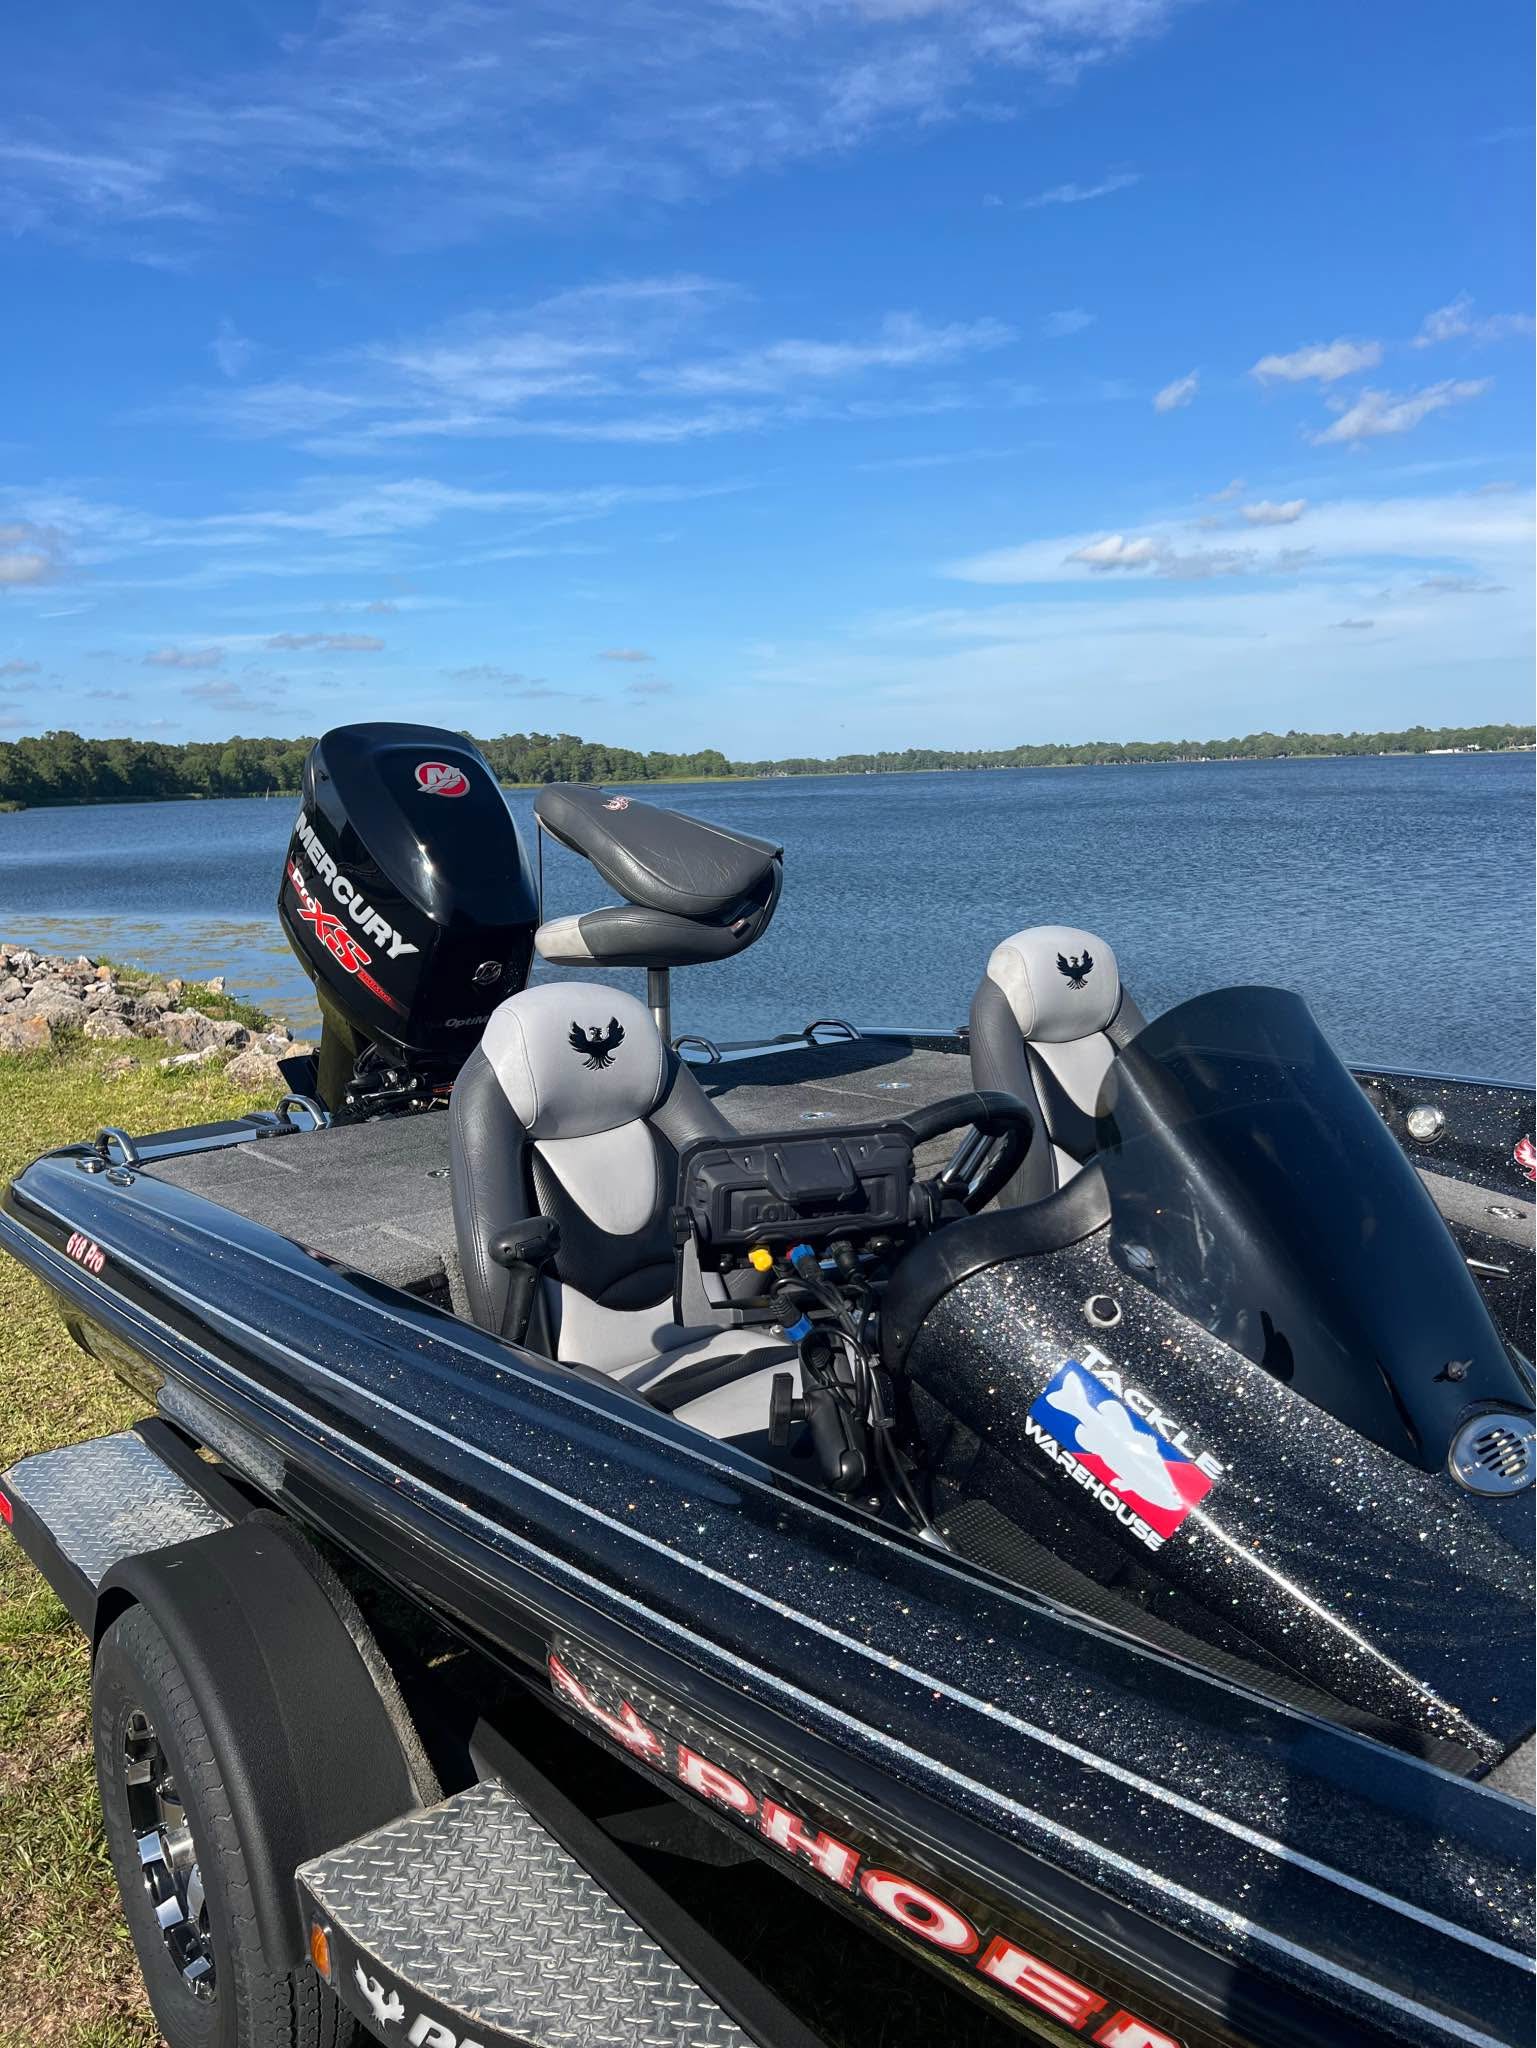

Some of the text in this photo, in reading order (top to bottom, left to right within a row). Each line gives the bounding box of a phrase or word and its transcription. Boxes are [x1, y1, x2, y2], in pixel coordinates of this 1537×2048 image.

[295, 811, 420, 960] MERCURY
[443, 1015, 489, 1030] OptiM
[66, 1231, 106, 1273] 618 Pro
[1081, 1344, 1225, 1481] TACKLE
[1024, 1415, 1167, 1552] WAREHOUSE
